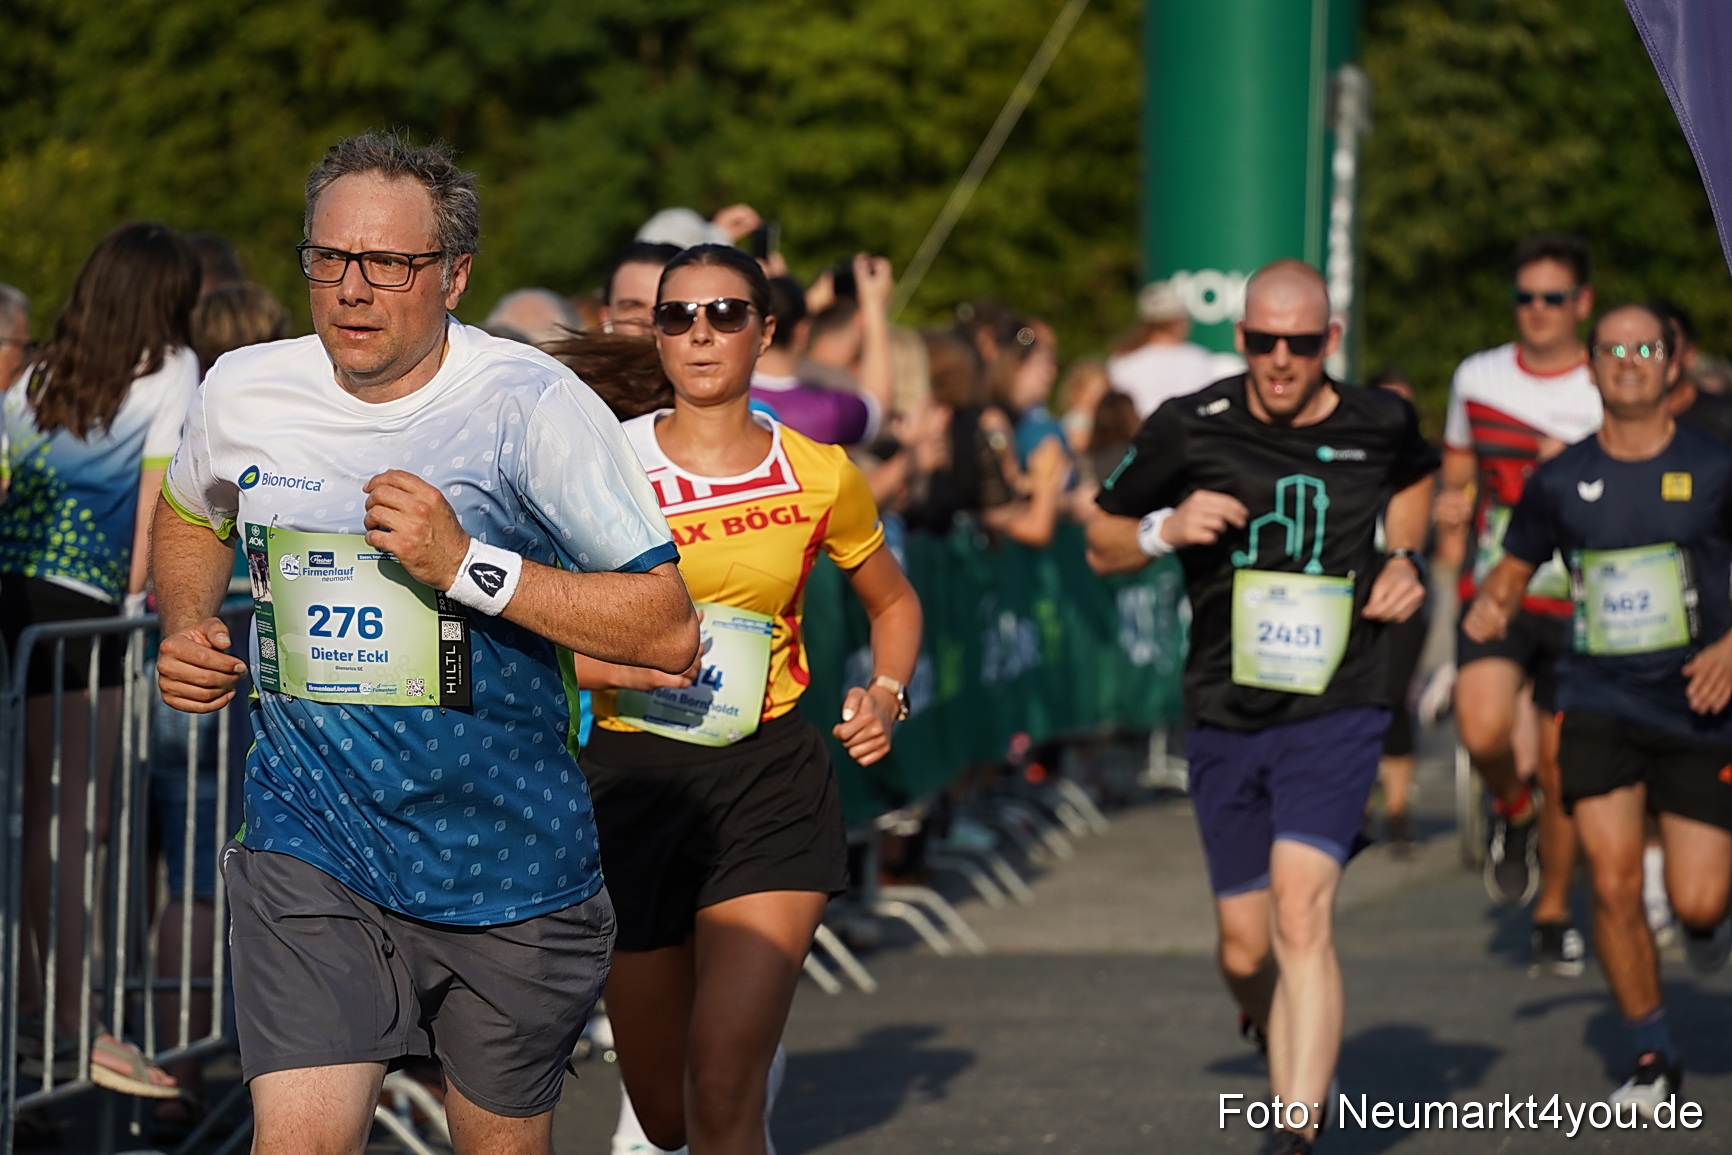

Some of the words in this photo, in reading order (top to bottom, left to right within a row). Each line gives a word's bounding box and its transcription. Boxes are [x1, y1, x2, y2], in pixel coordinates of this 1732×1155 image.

[262, 472, 321, 491] Bionorica
[671, 521, 712, 547] AX
[721, 504, 811, 537] BÖGL
[248, 536, 265, 547] AOK
[303, 567, 354, 577] Firmenlauf
[307, 604, 384, 640] 276
[1258, 621, 1322, 646] 2451
[311, 647, 354, 662] Dieter
[357, 649, 388, 663] Eckl
[446, 645, 457, 694] HILTL
